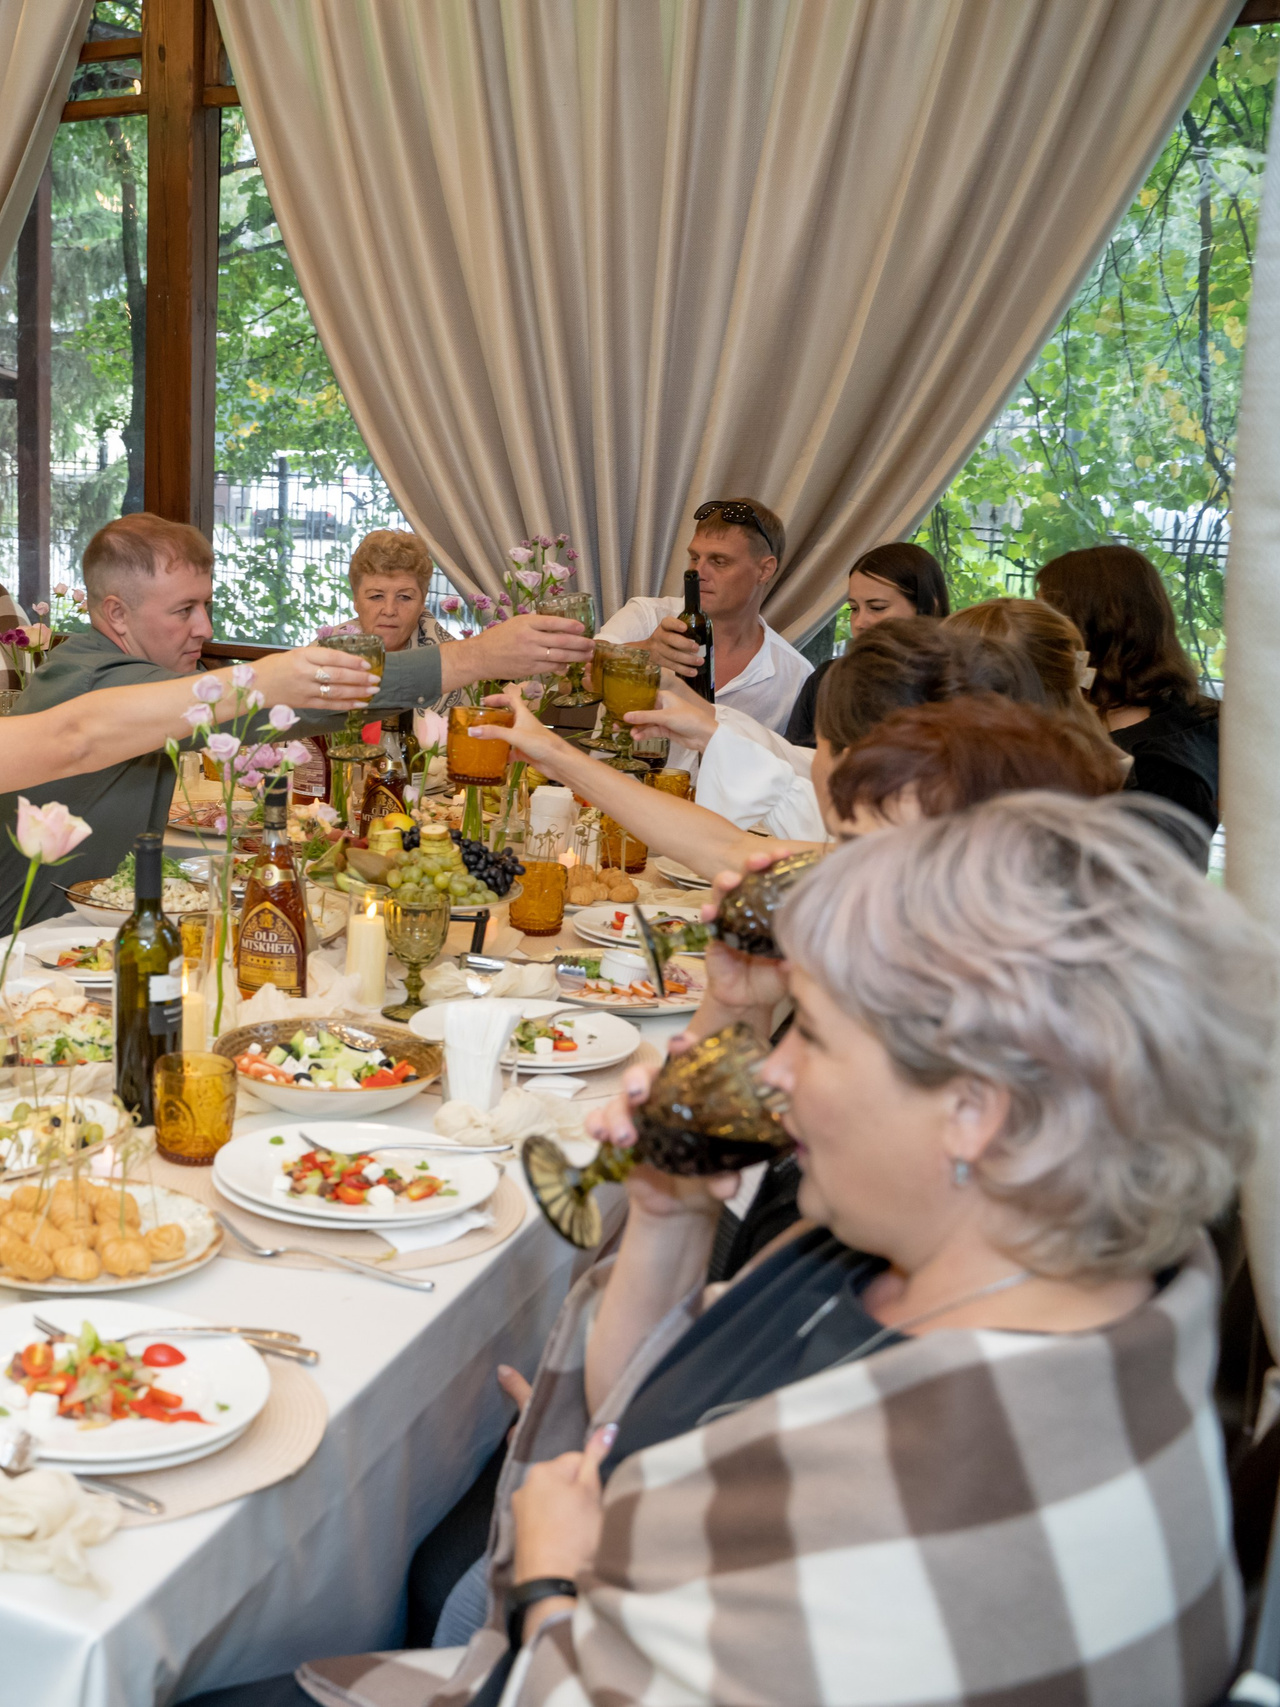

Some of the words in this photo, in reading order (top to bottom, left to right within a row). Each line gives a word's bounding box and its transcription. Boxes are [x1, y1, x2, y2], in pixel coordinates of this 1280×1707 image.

[264, 870, 273, 880] 5
[254, 931, 278, 943] OLD
[241, 938, 296, 954] MTSKHETA
